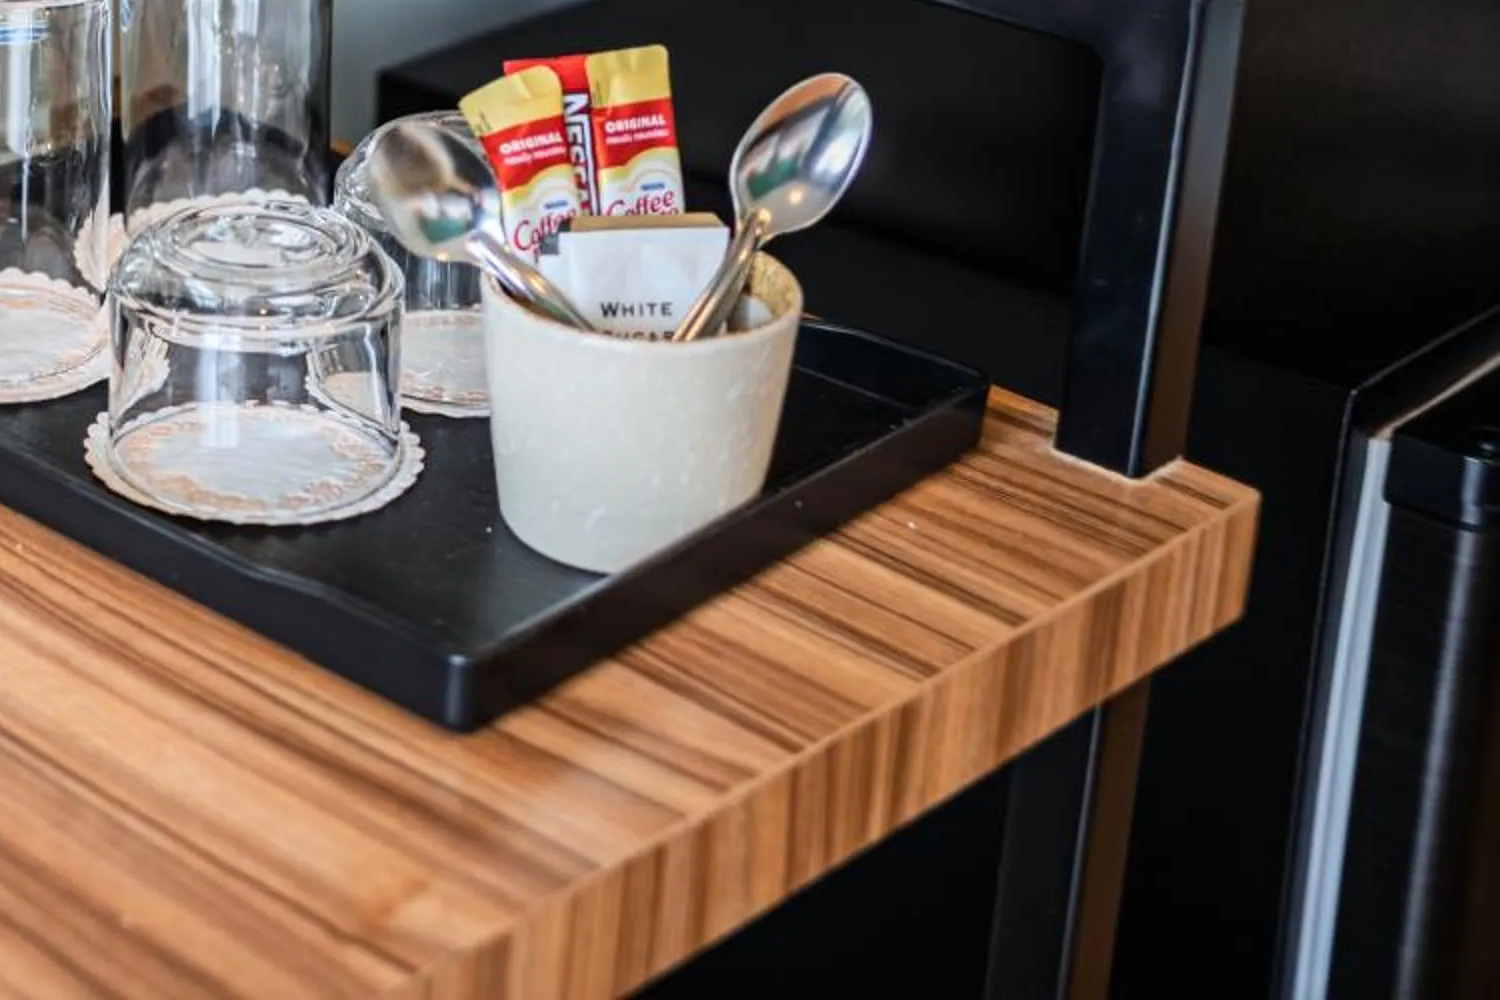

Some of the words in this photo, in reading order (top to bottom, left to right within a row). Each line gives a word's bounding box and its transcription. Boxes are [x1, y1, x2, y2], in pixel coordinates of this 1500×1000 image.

[605, 114, 665, 133] ORIGINAL
[499, 130, 563, 156] ORIGINAL
[601, 301, 673, 318] WHITE
